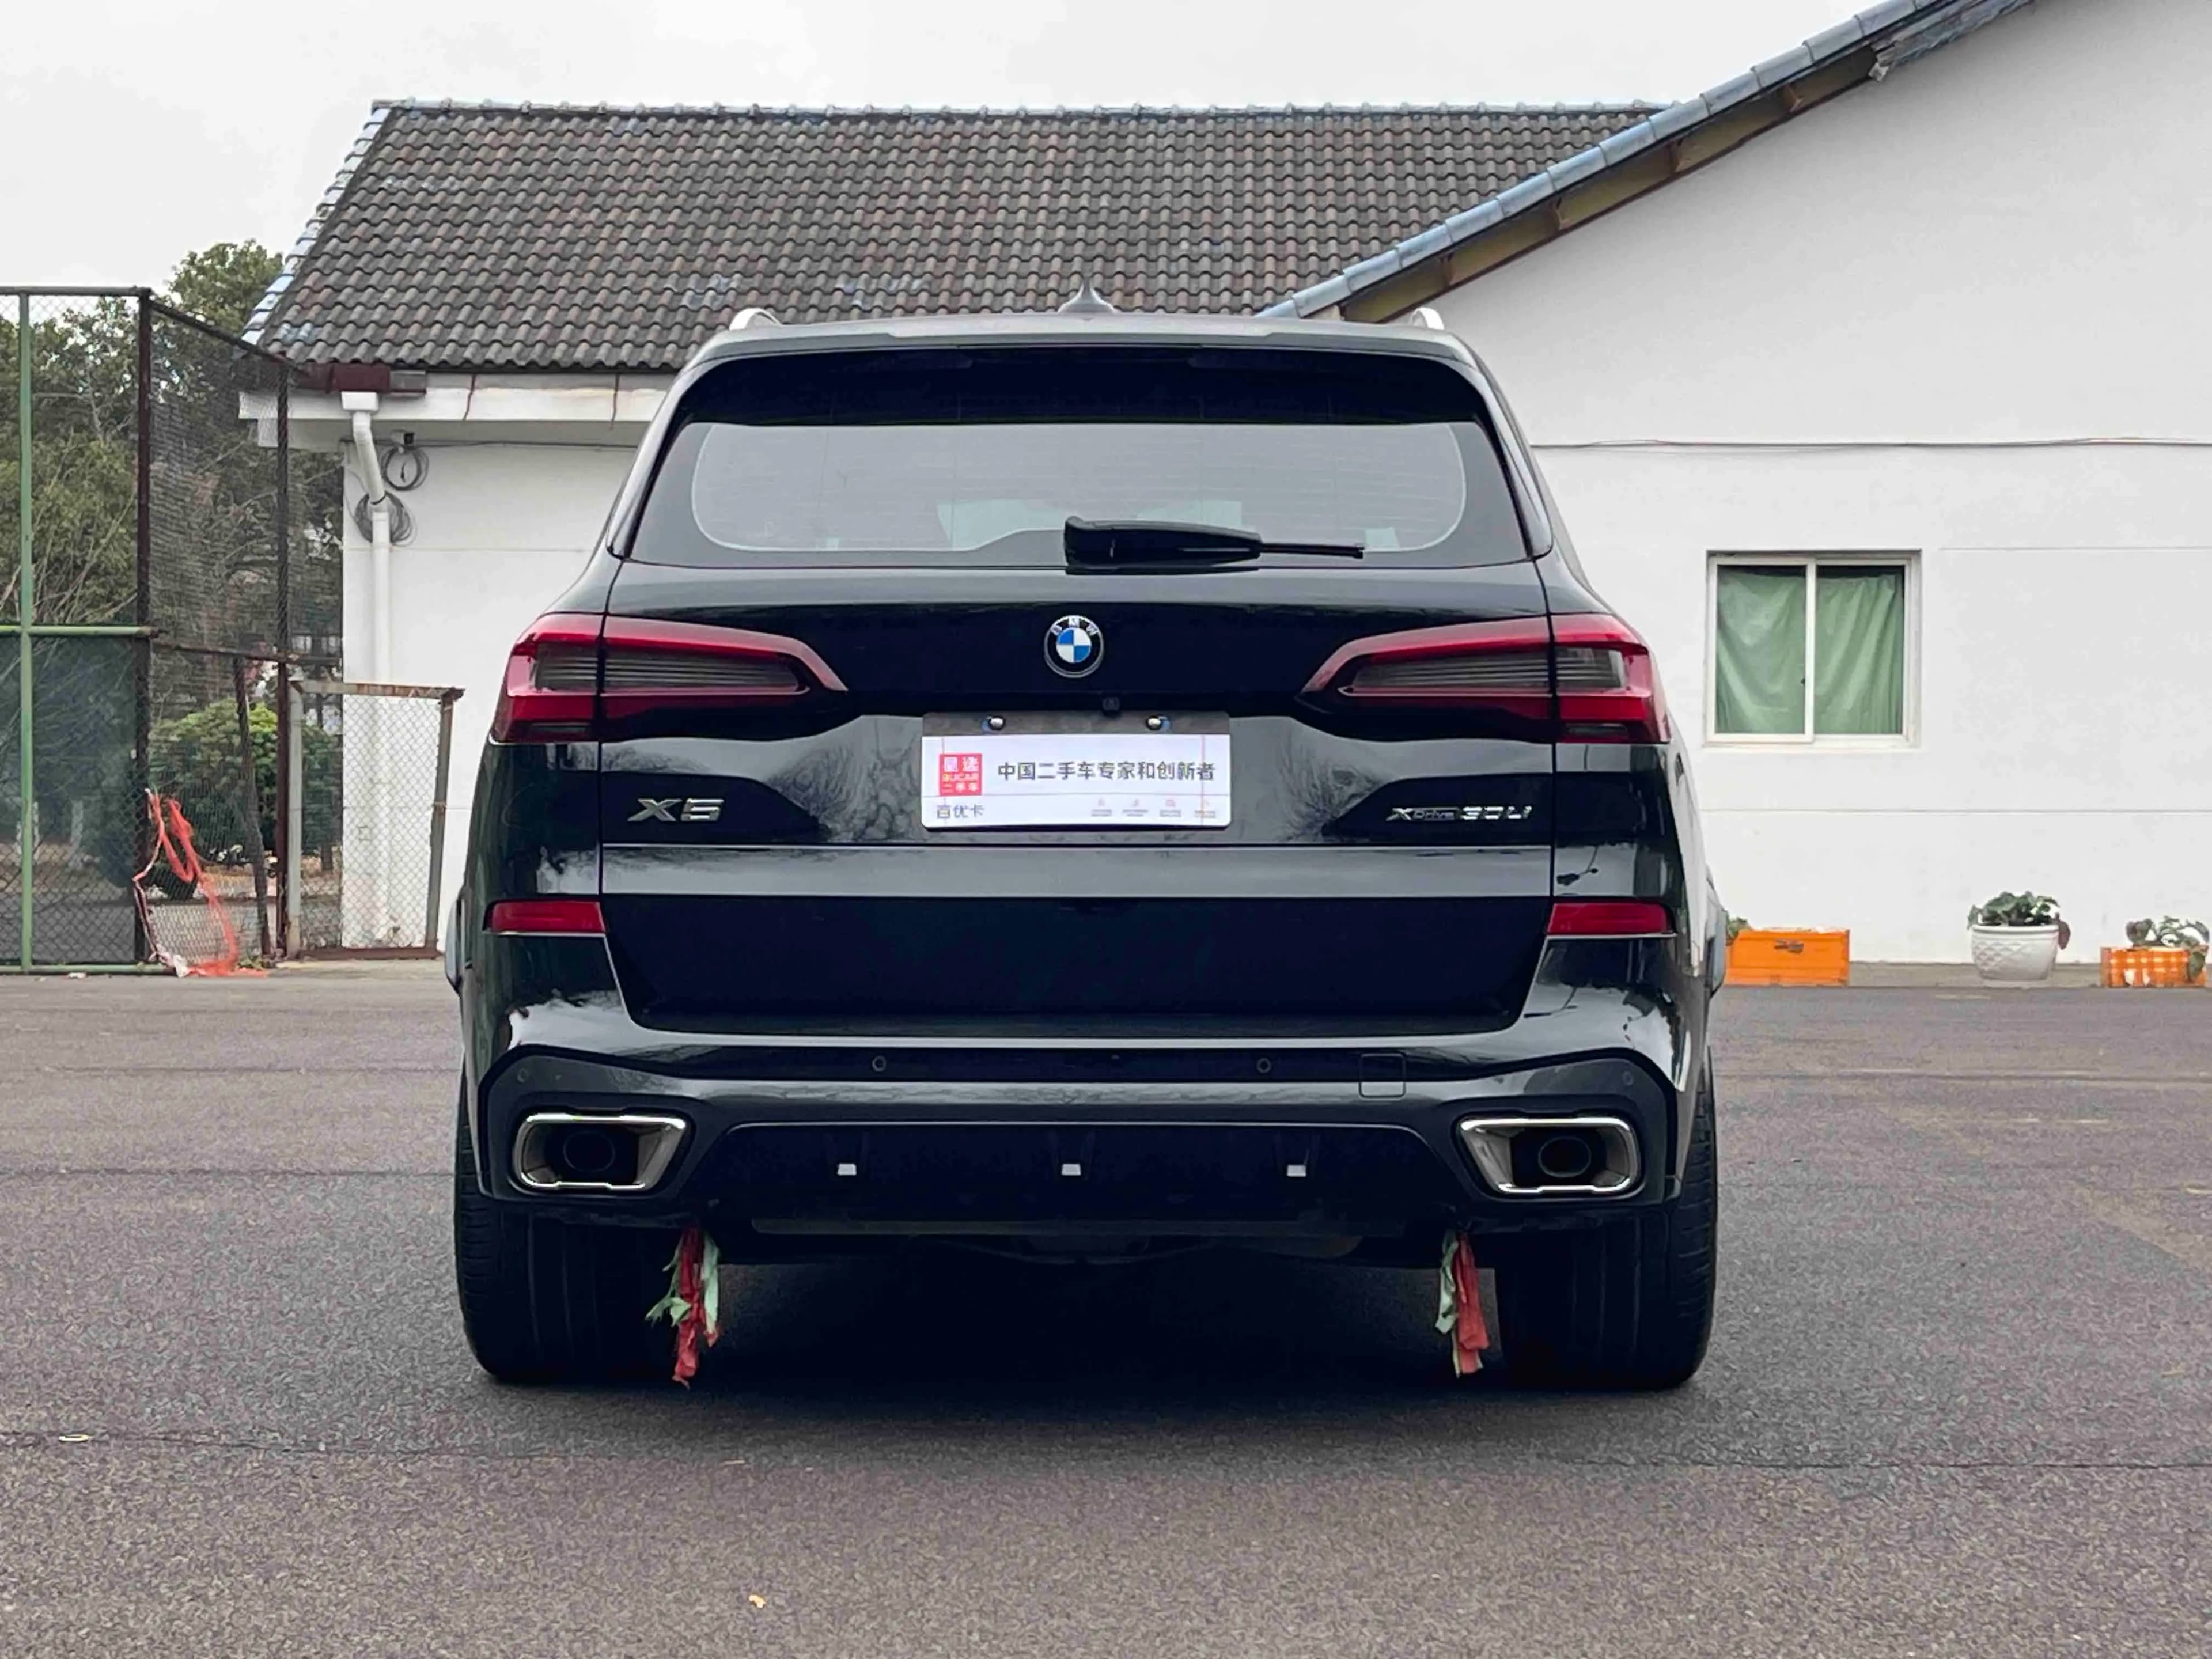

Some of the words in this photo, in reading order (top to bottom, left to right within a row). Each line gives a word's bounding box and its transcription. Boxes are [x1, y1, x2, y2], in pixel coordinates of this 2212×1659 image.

[998, 762, 1215, 781] 中国二手车专家和创新者
[627, 798, 724, 821] X5
